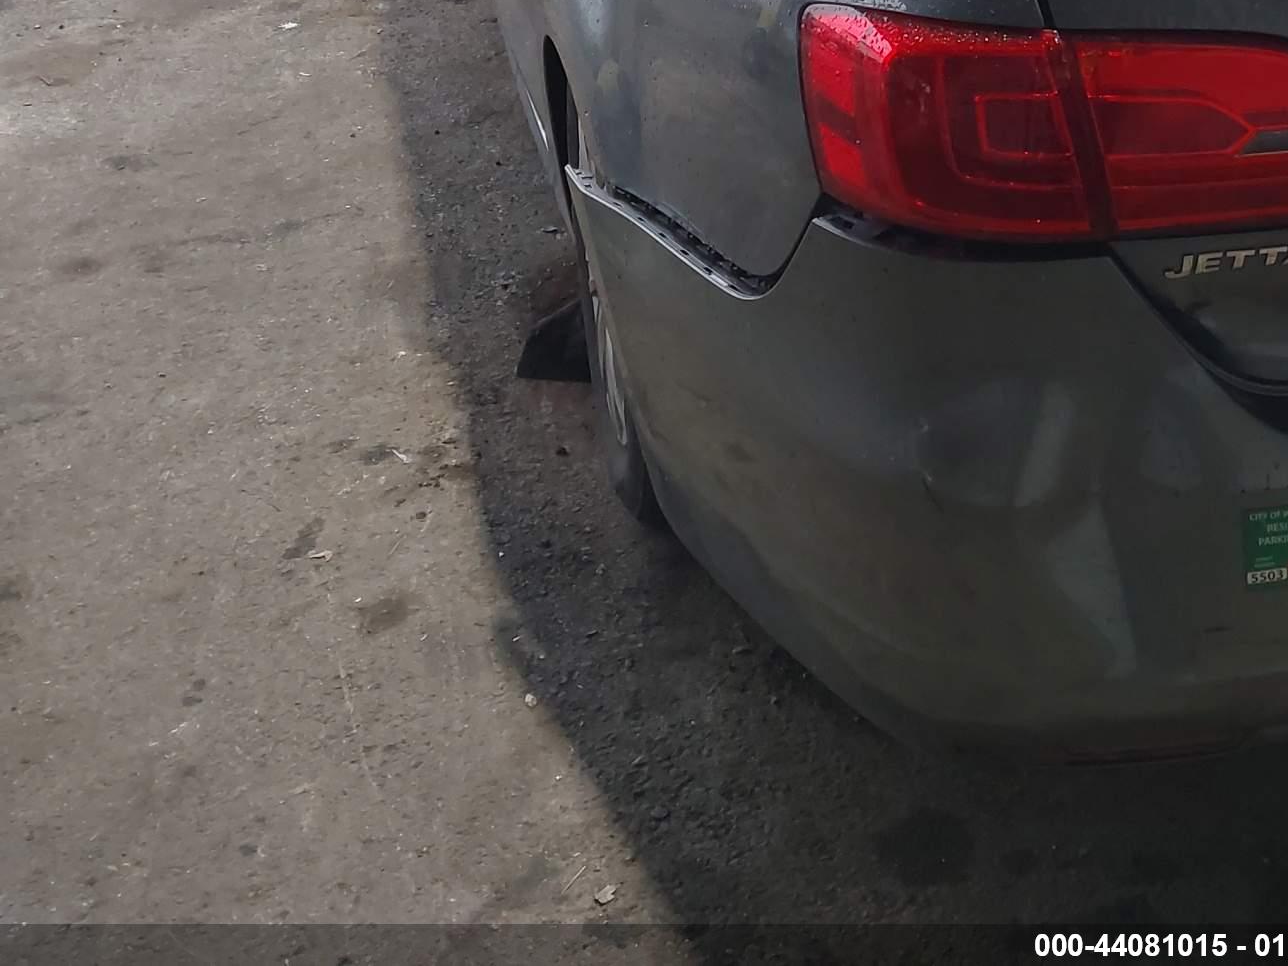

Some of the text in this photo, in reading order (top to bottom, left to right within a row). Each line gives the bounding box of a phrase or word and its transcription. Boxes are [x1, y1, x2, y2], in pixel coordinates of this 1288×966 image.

[1249, 511, 1268, 522] CITY
[1269, 510, 1282, 519] OF
[1251, 569, 1284, 583] 5503
